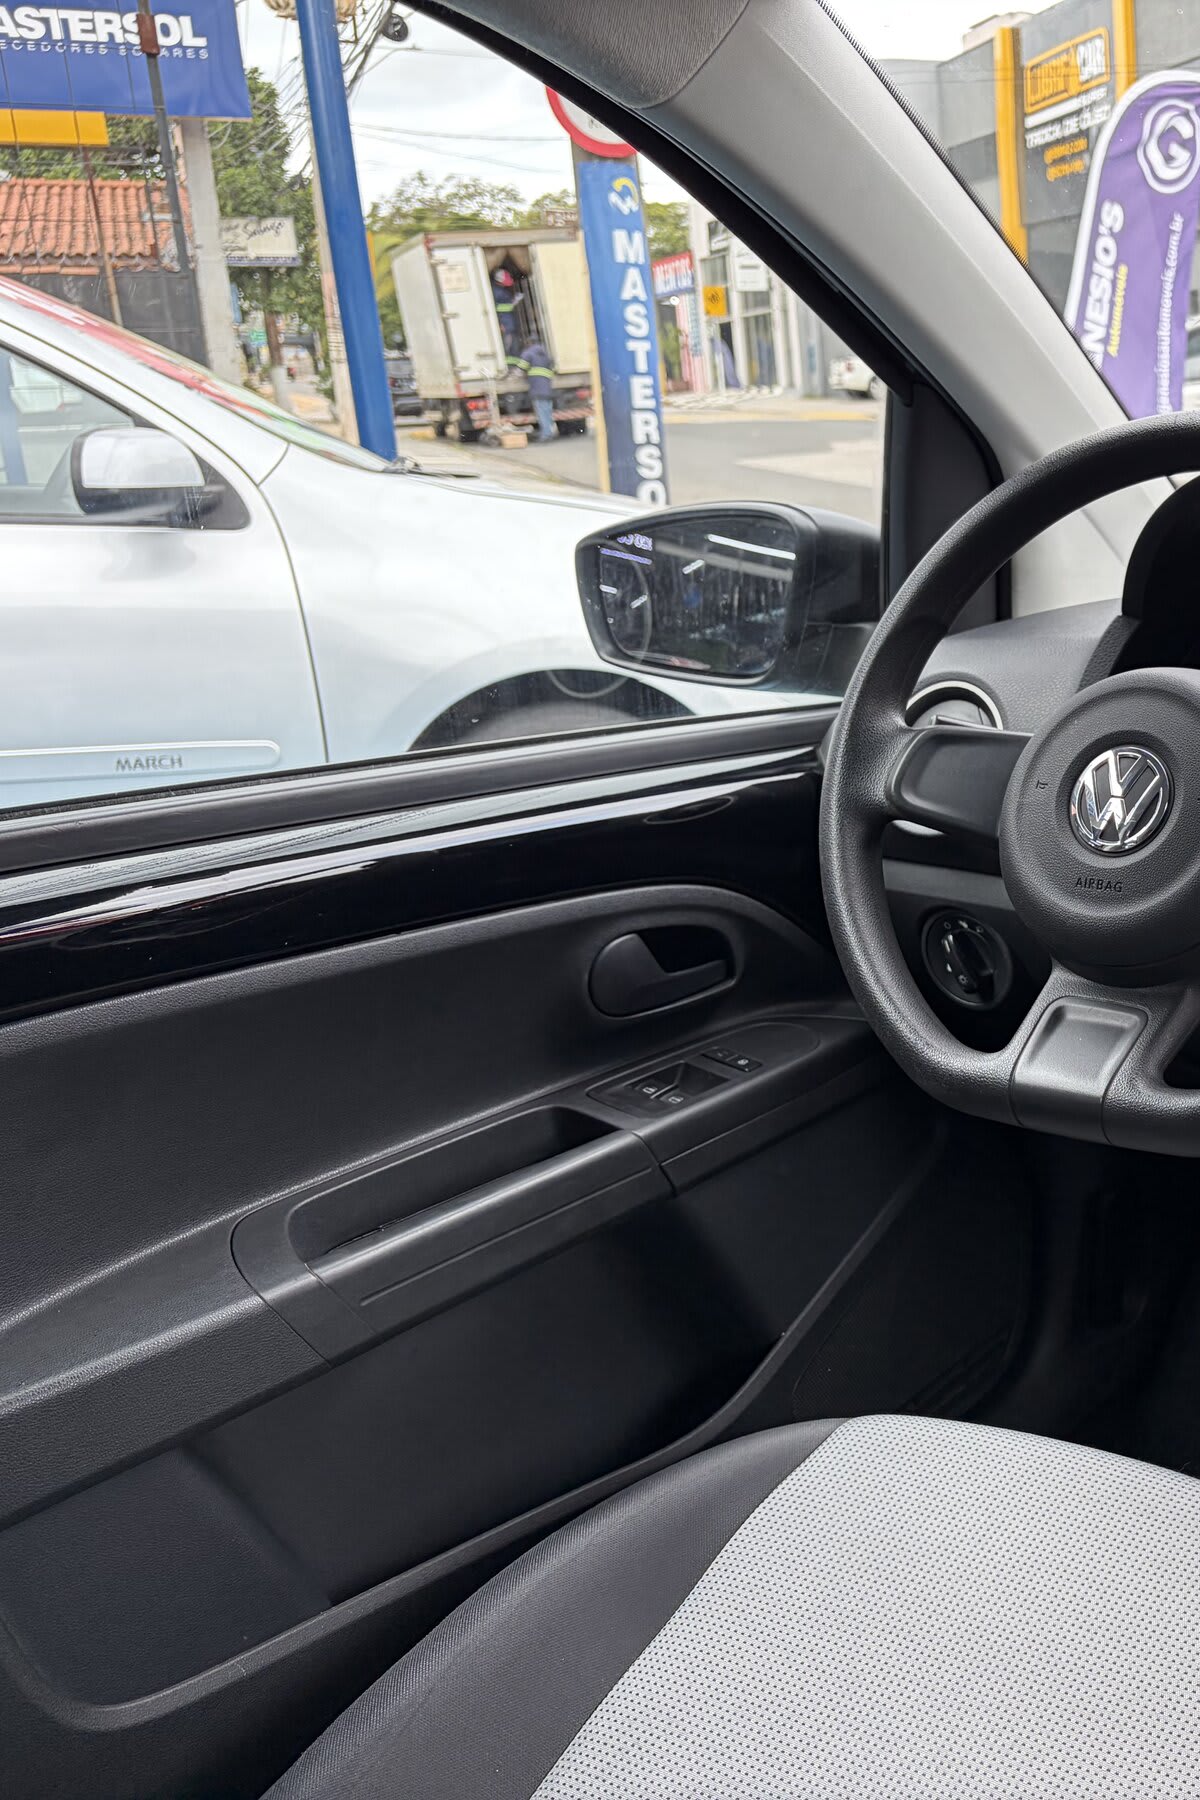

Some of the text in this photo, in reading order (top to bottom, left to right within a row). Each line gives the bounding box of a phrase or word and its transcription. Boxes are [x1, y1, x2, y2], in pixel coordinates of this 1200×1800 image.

[118, 45, 209, 59] SOARES
[1081, 200, 1124, 368] NESIO'S
[115, 753, 183, 772] MARCH
[1075, 877, 1124, 893] AIRBAG
